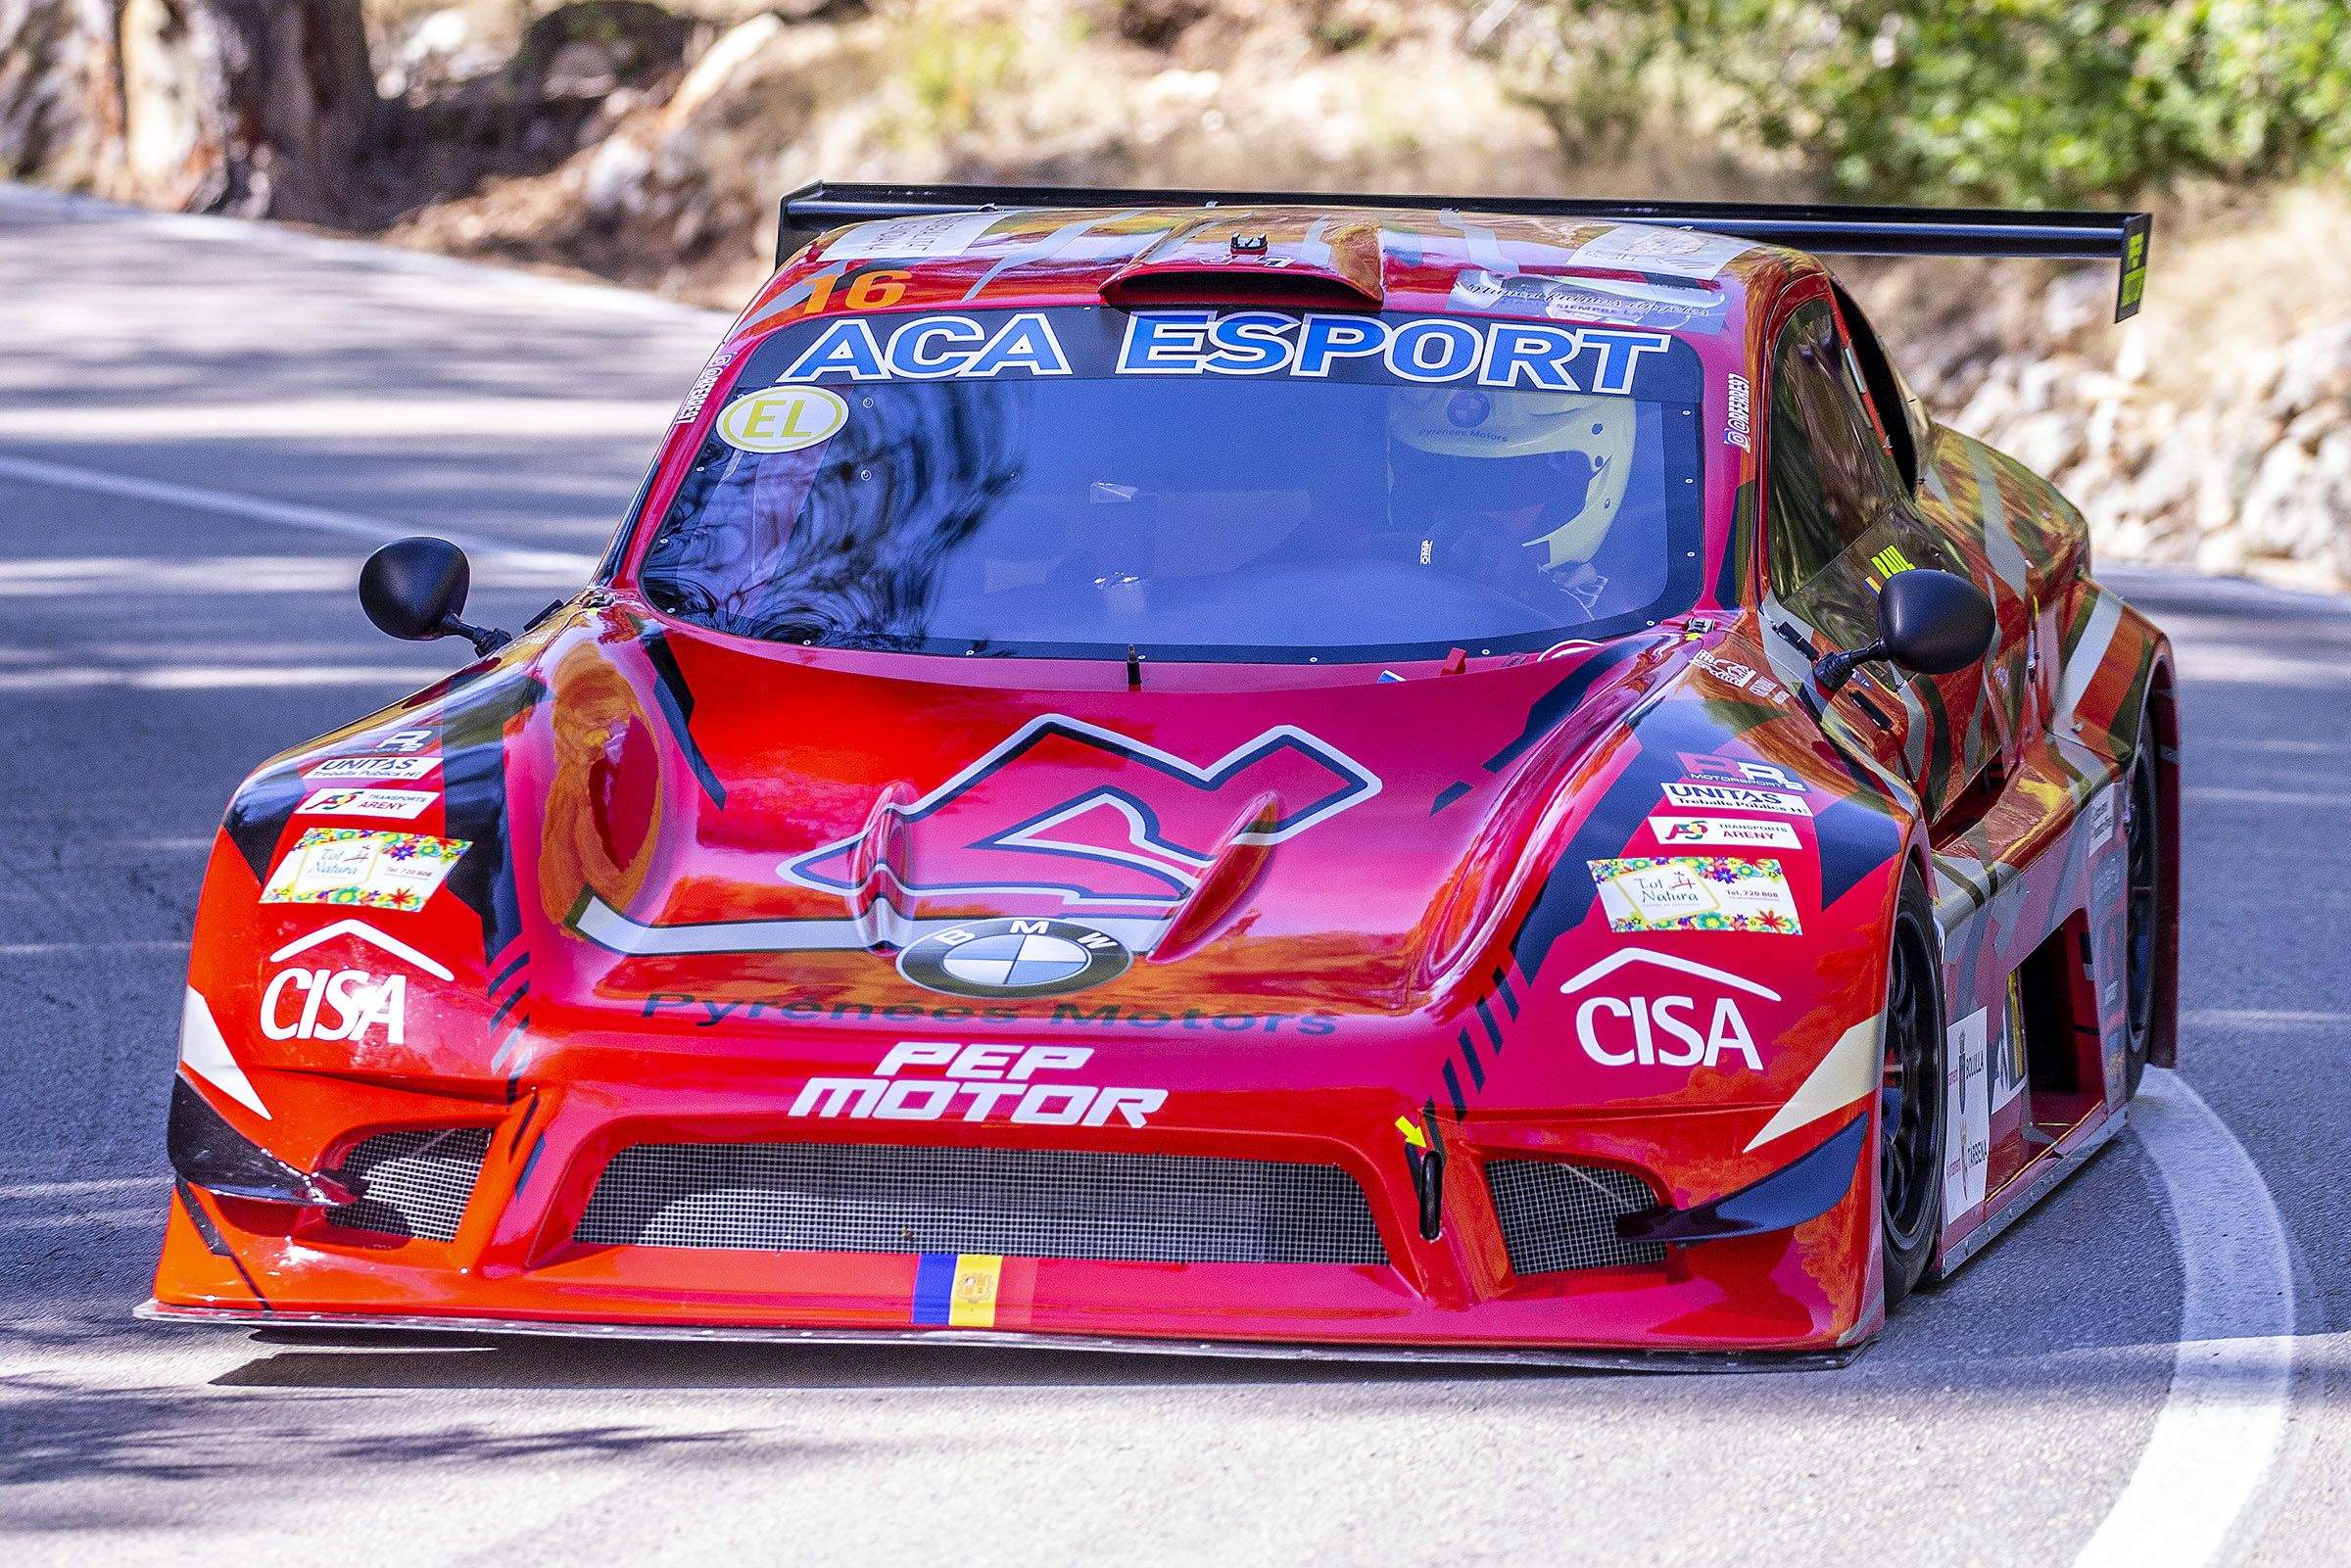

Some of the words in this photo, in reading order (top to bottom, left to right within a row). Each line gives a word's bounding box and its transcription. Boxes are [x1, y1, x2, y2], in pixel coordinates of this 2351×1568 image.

[802, 270, 913, 314] 16
[775, 313, 1073, 383] ACA
[1115, 311, 1671, 394] ESPORT
[743, 400, 812, 438] EL
[321, 759, 418, 770] UNITAS
[358, 801, 407, 810] ARENY
[369, 794, 428, 803] TRANSPORTS
[1669, 785, 1782, 803] UNITAS
[1719, 823, 1789, 832] TRANSPORTS
[1723, 831, 1775, 840] ARENY
[1642, 890, 1699, 902] Natura
[935, 920, 1118, 950] BMW
[260, 968, 408, 1045] CISA
[1050, 1001, 1337, 1036] Motors
[1576, 995, 1764, 1070] CISA
[872, 1041, 1095, 1078] PEP
[787, 1077, 1169, 1129] MOTOR
